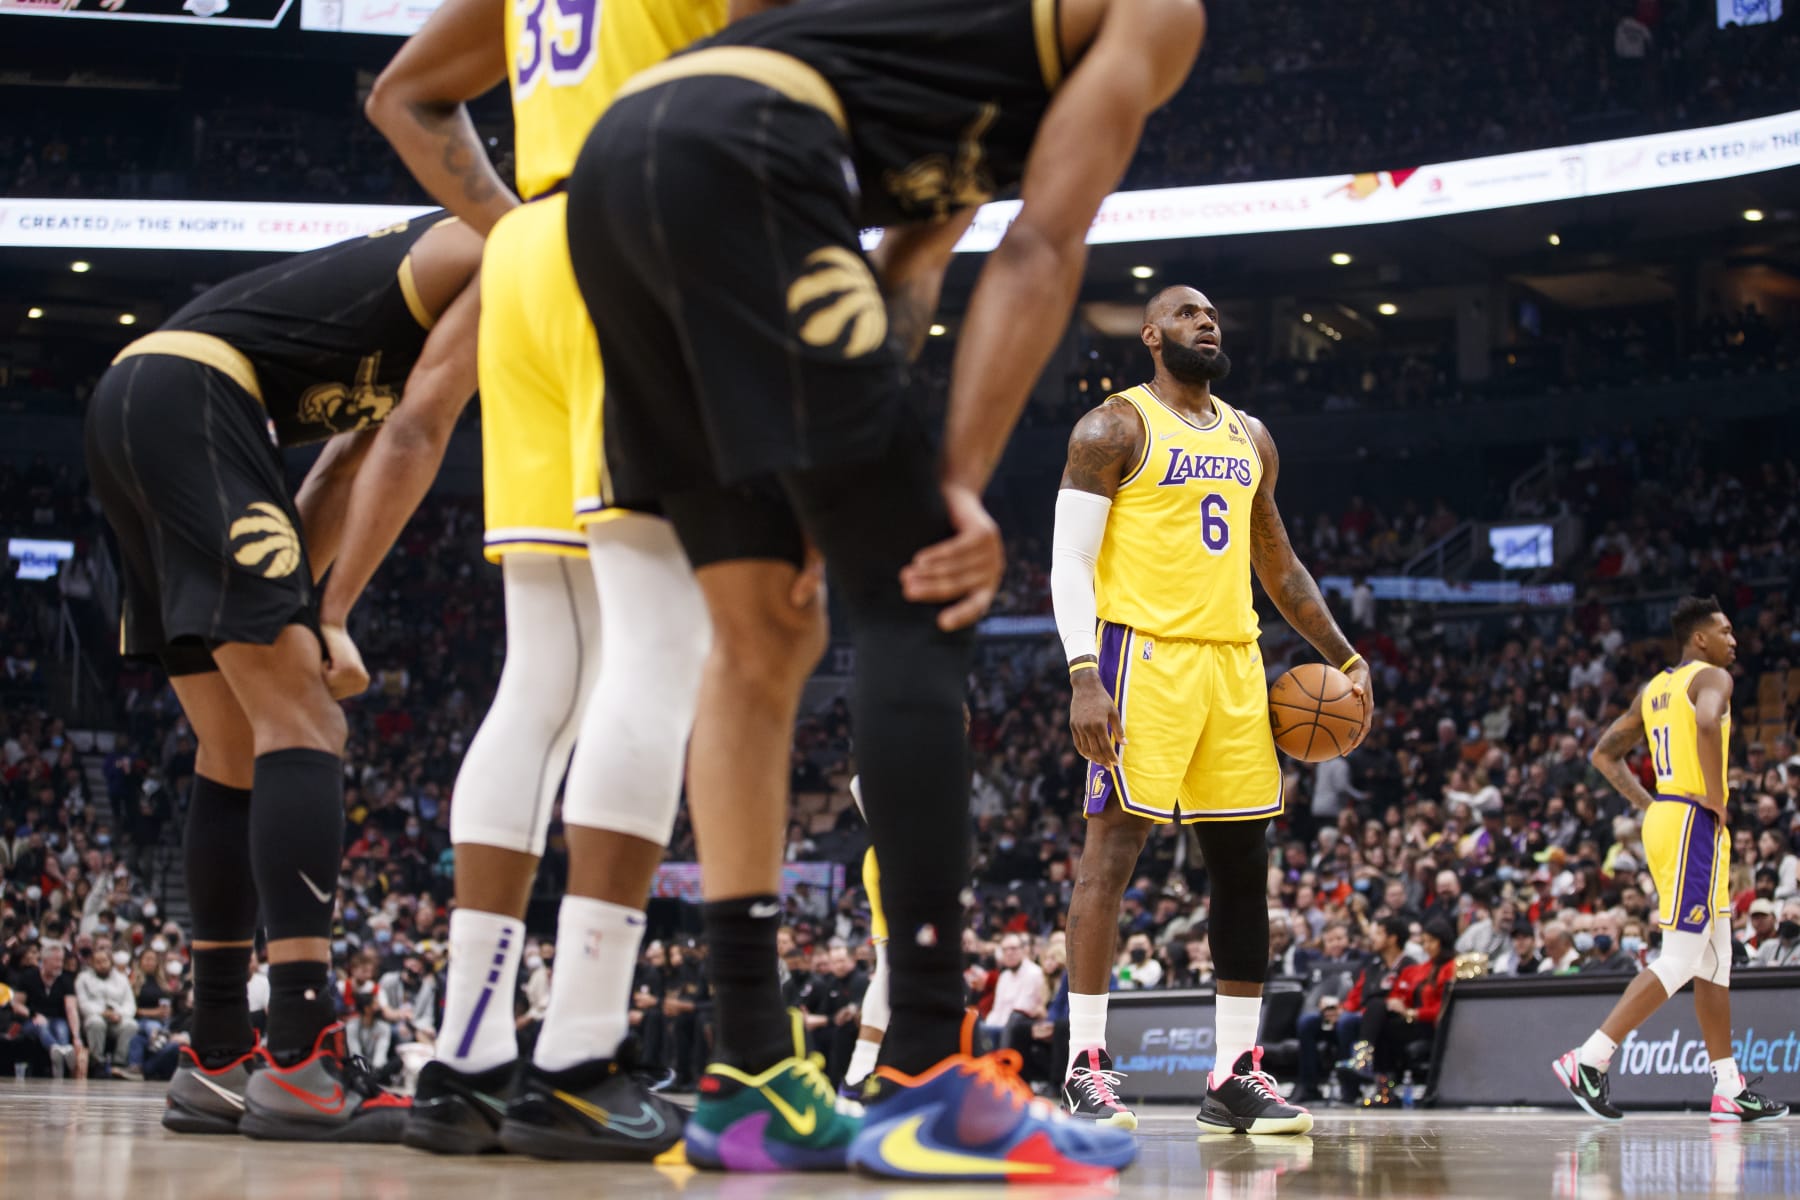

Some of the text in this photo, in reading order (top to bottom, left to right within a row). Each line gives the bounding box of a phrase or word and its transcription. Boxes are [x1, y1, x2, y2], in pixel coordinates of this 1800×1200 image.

[516, 0, 602, 86] 39
[1655, 141, 1743, 167] CREATED
[18, 215, 109, 231] CREATED
[138, 217, 171, 231] THE
[178, 219, 245, 232] NORTH
[257, 219, 350, 233] CREATED
[1093, 206, 1172, 224] REATED
[1158, 448, 1252, 487] LAKERS
[1200, 493, 1230, 556] 6
[1653, 726, 1673, 777] 11
[1140, 1027, 1214, 1051] F-150
